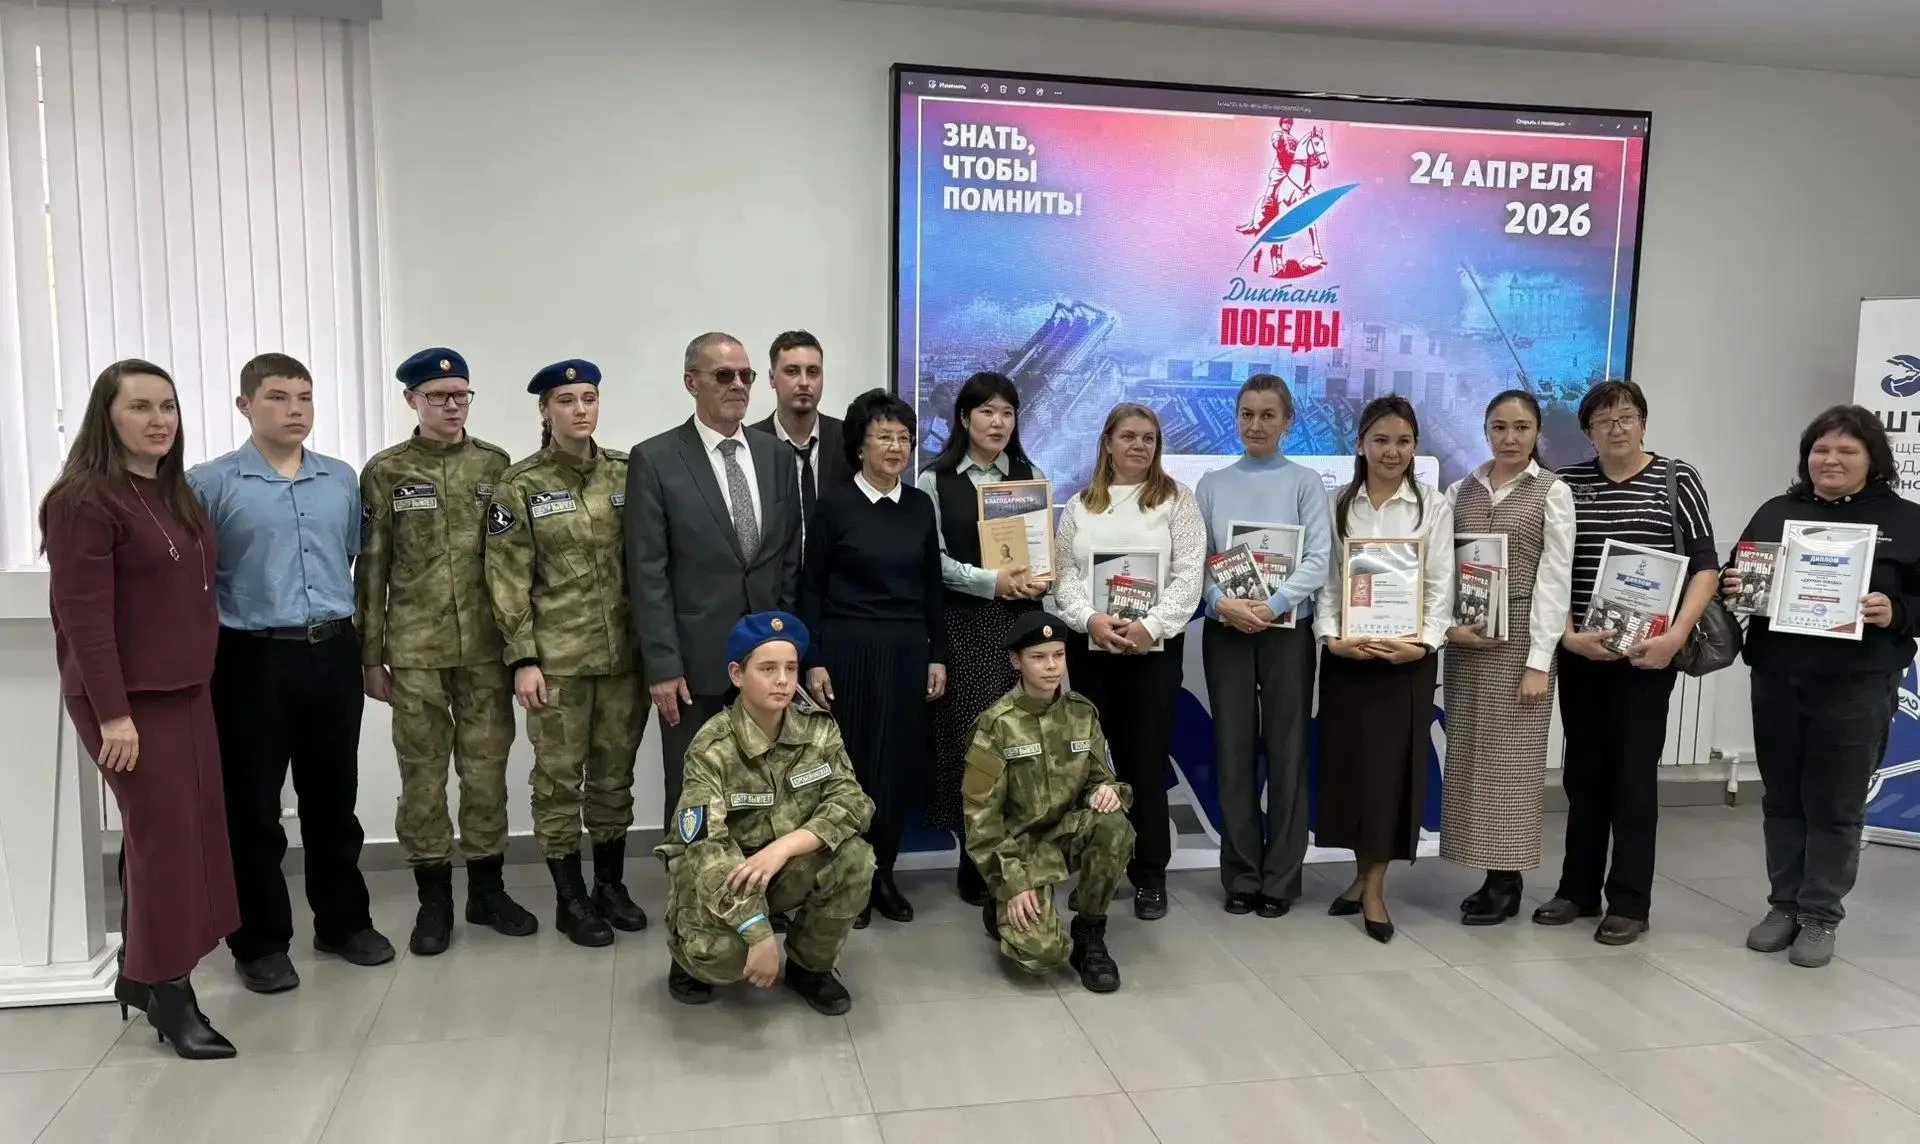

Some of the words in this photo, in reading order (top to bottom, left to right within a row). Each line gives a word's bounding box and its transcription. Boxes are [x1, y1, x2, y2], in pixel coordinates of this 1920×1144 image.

[943, 123, 1036, 155] ЗНАТЬ,
[943, 155, 1038, 183] ЧТОБЫ
[1410, 151, 1455, 188] 24
[1461, 159, 1594, 192] АПРЕЛЯ
[943, 186, 1083, 216] ПОМНИТЬ!
[1505, 202, 1593, 237] 2026
[1223, 277, 1341, 304] Диктант
[1220, 308, 1341, 353] ПОБЕДЫ
[1216, 561, 1252, 582] ВОЙНЫ
[1810, 555, 1840, 563] ДИПЛОМ
[1113, 595, 1150, 611] ВОЙНЫ
[1461, 583, 1488, 599] ВОЙНЫ
